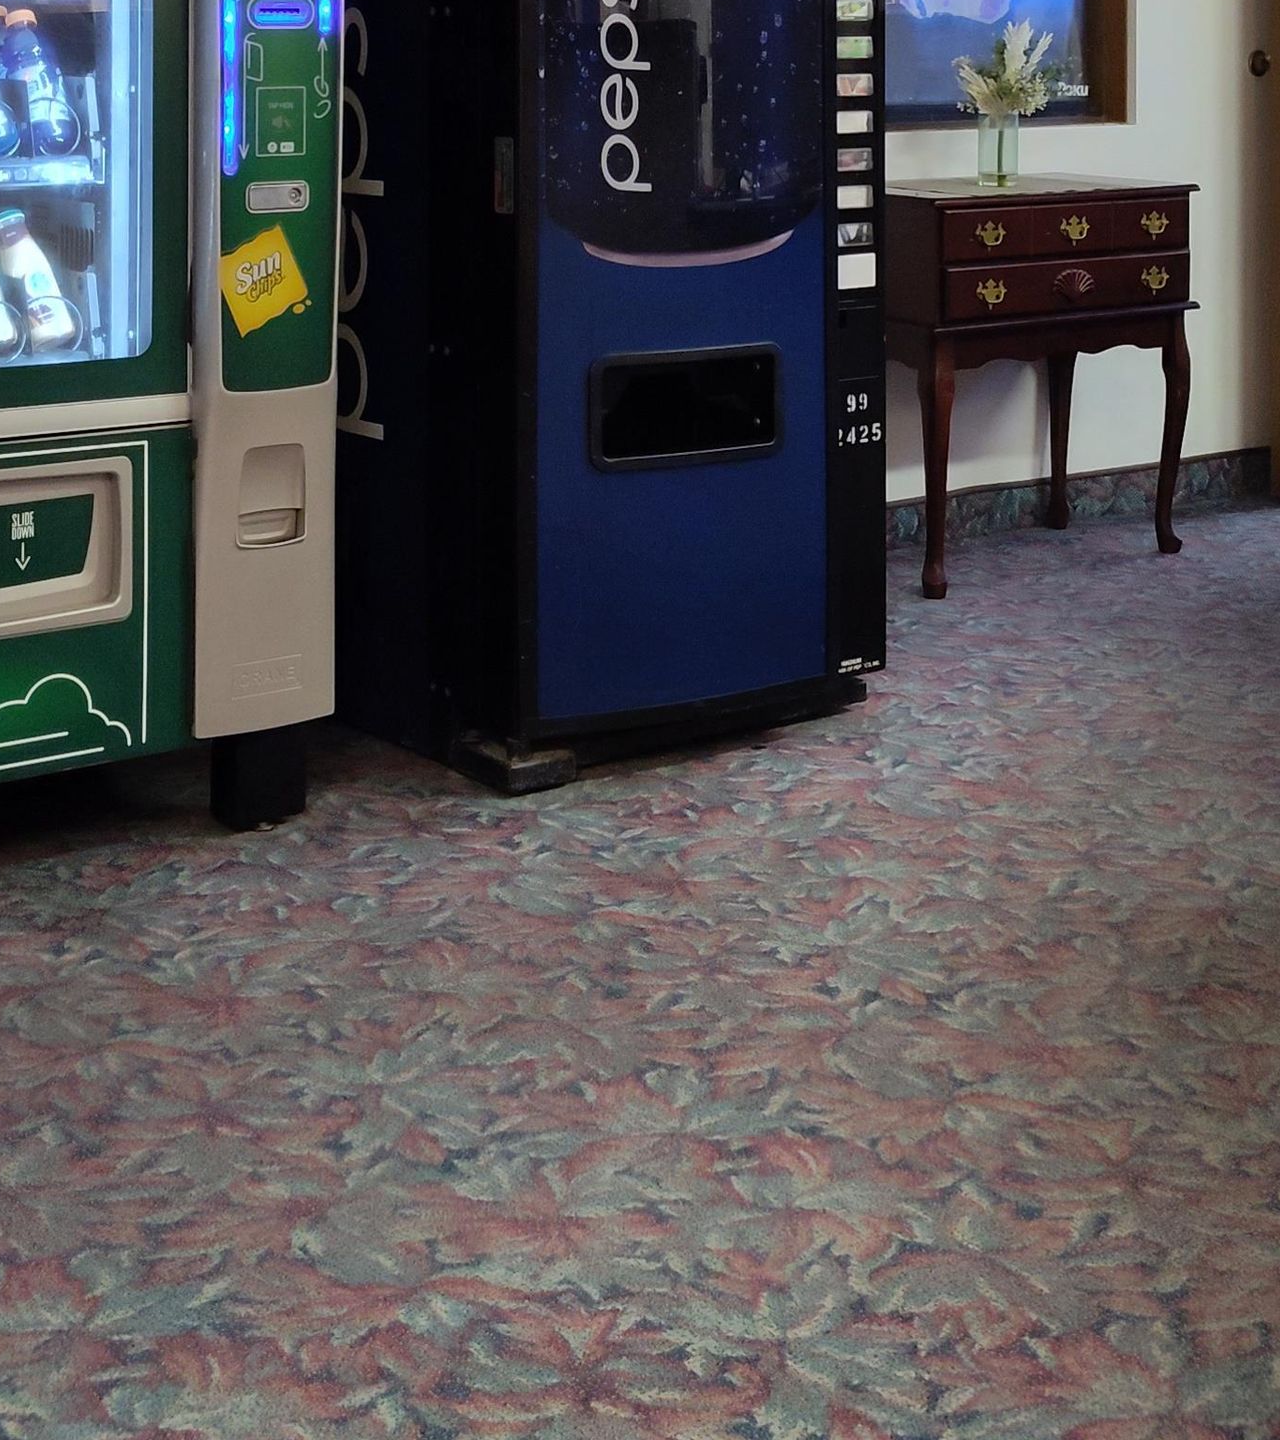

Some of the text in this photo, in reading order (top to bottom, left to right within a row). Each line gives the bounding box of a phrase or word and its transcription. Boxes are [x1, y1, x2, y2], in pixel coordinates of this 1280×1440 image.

[235, 251, 282, 297] Sun
[846, 392, 869, 413] 99
[11, 510, 35, 527] SLIDE
[11, 524, 35, 540] DOWN
